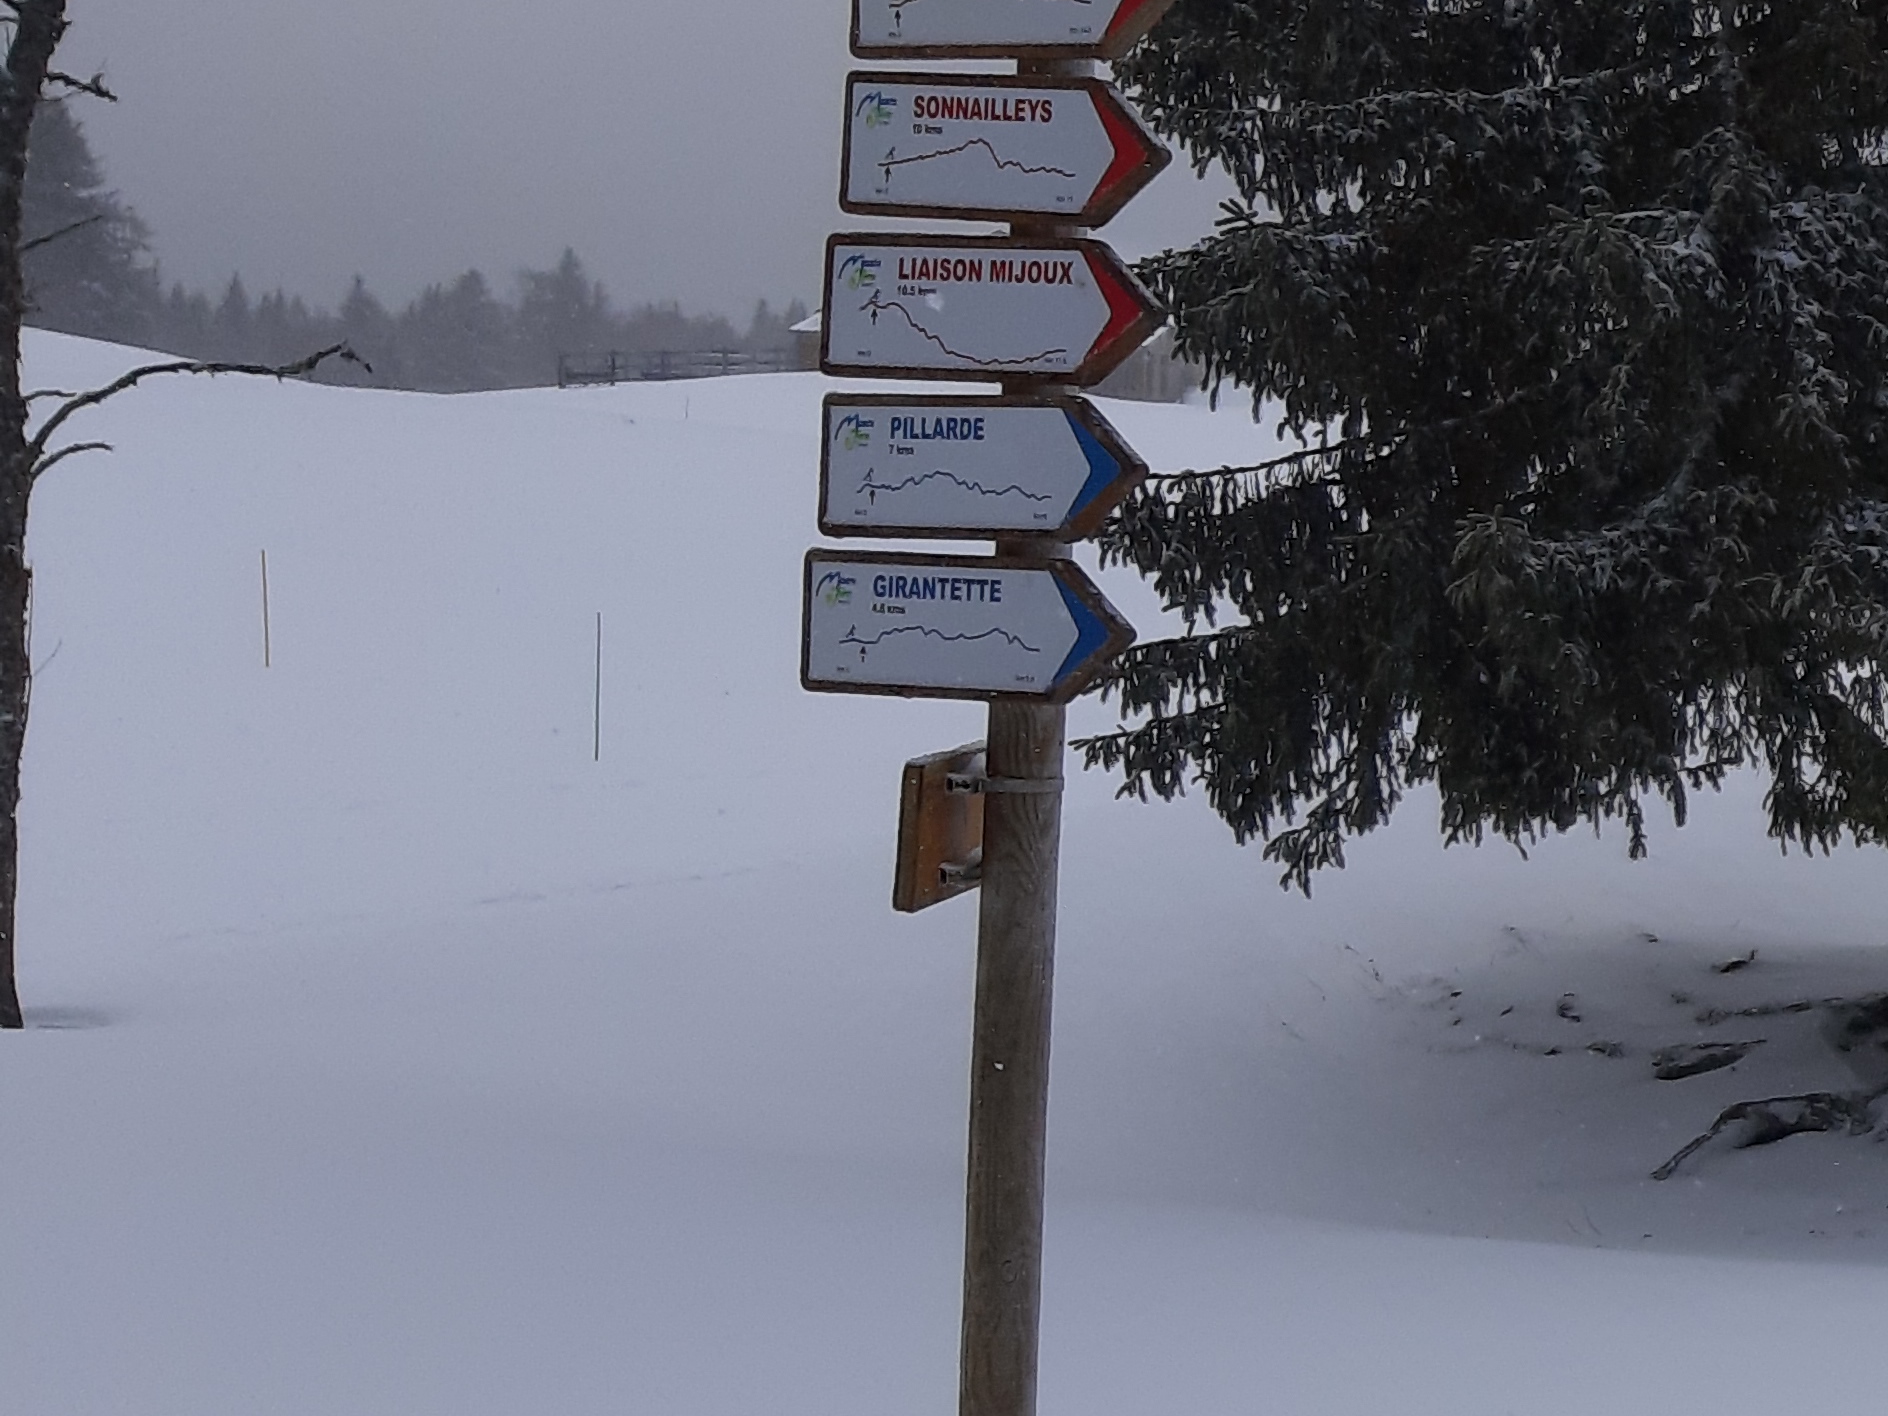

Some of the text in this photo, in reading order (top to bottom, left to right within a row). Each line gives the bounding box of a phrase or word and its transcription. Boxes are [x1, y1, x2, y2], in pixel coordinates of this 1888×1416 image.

[912, 95, 1054, 123] SONNAILLEYS
[897, 256, 983, 282] LIAISON
[989, 260, 1074, 285] MIJOUX
[889, 416, 986, 441] PILLARDE
[872, 575, 1003, 603] GIRANTETTE
